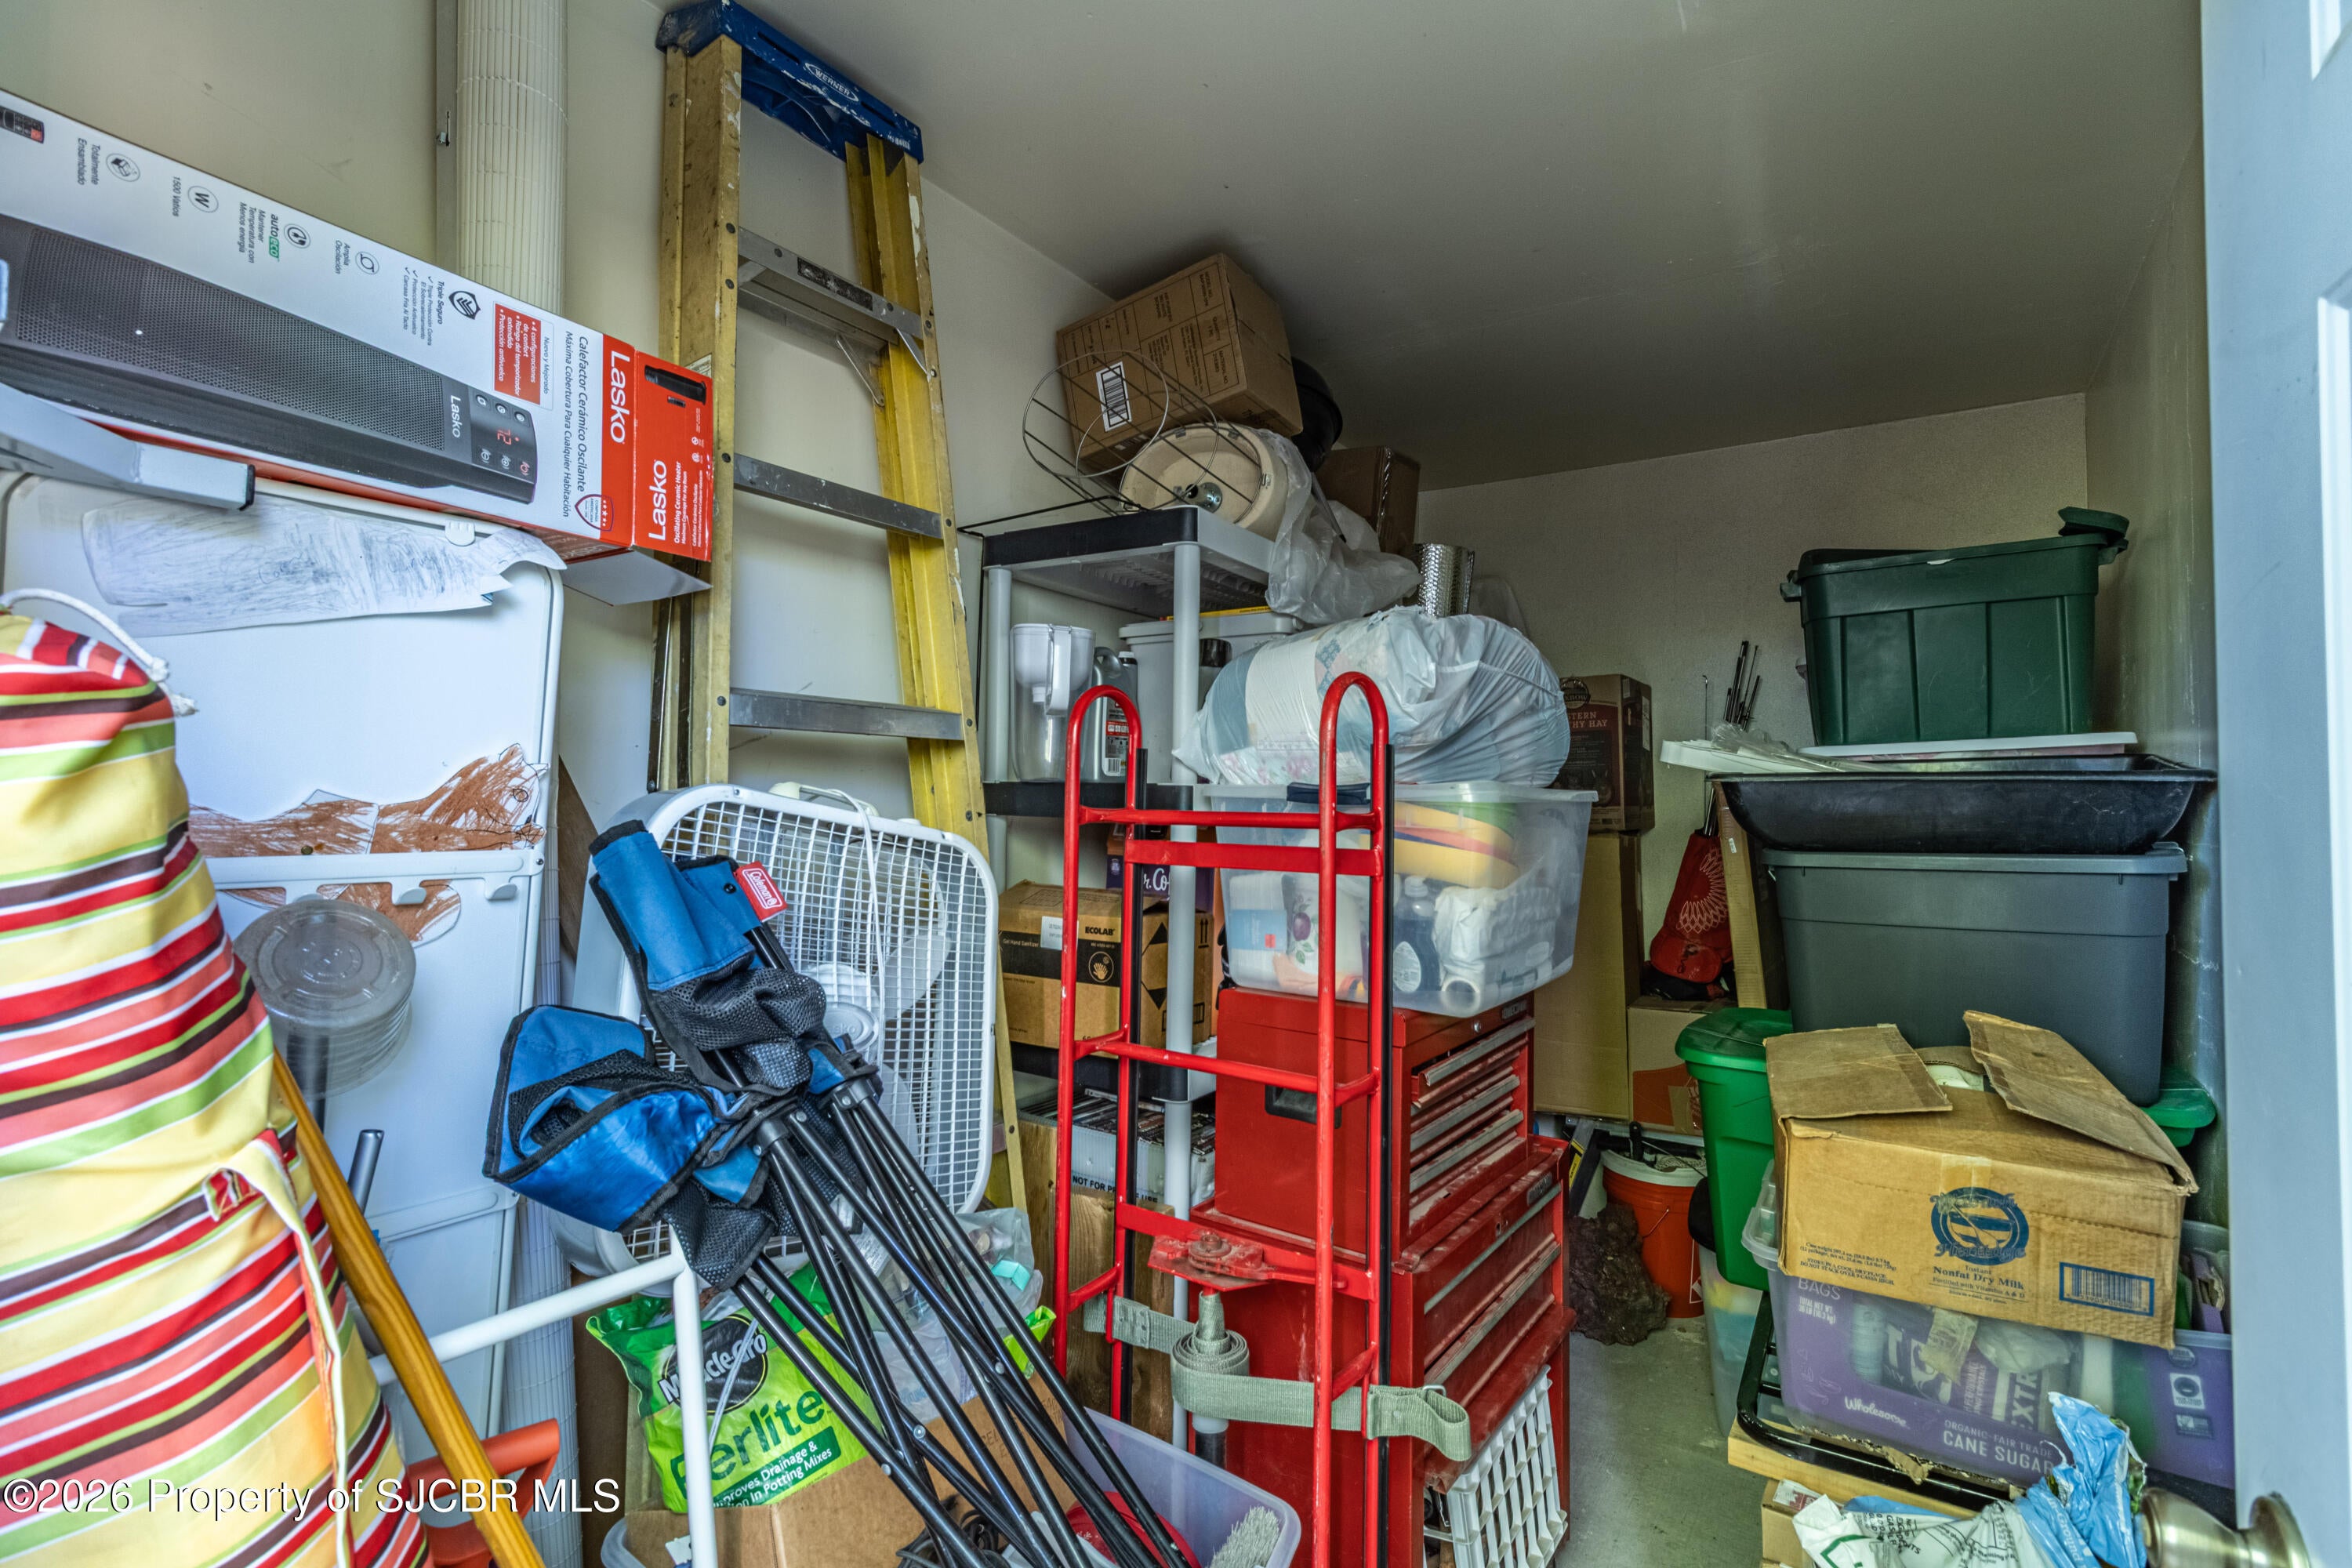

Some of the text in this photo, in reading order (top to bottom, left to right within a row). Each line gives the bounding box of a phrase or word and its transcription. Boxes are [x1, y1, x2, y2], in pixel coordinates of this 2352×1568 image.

[814, 68, 851, 96] WERNER
[564, 365, 573, 409] Cobertura
[610, 350, 630, 445] Lasko
[450, 395, 463, 438] Lasko
[564, 411, 572, 429] Para
[577, 336, 589, 492] Calefactor Cerámico Oscilante
[563, 430, 572, 471] Cualquier
[563, 472, 572, 517] Habitación
[648, 459, 667, 541] Lasko
[673, 510, 682, 543] Oscillating
[750, 872, 773, 900] Coleman
[1085, 926, 1114, 936] ECOLAB
[1073, 1175, 1087, 1186] NOT
[1090, 1179, 1105, 1190] FOR
[1798, 1278, 1841, 1300] BAGS
[1933, 1265, 2024, 1290] Nonfat Dry Milk
[1844, 1395, 1907, 1427] Wholesome
[1943, 1429, 1988, 1457] CANE
[1994, 1434, 2016, 1447] FAIR
[750, 1490, 762, 1503] In
[763, 1466, 805, 1494] Potting
[804, 1447, 833, 1472] Mixes
[760, 1449, 808, 1482] Drainage
[808, 1440, 818, 1451] &
